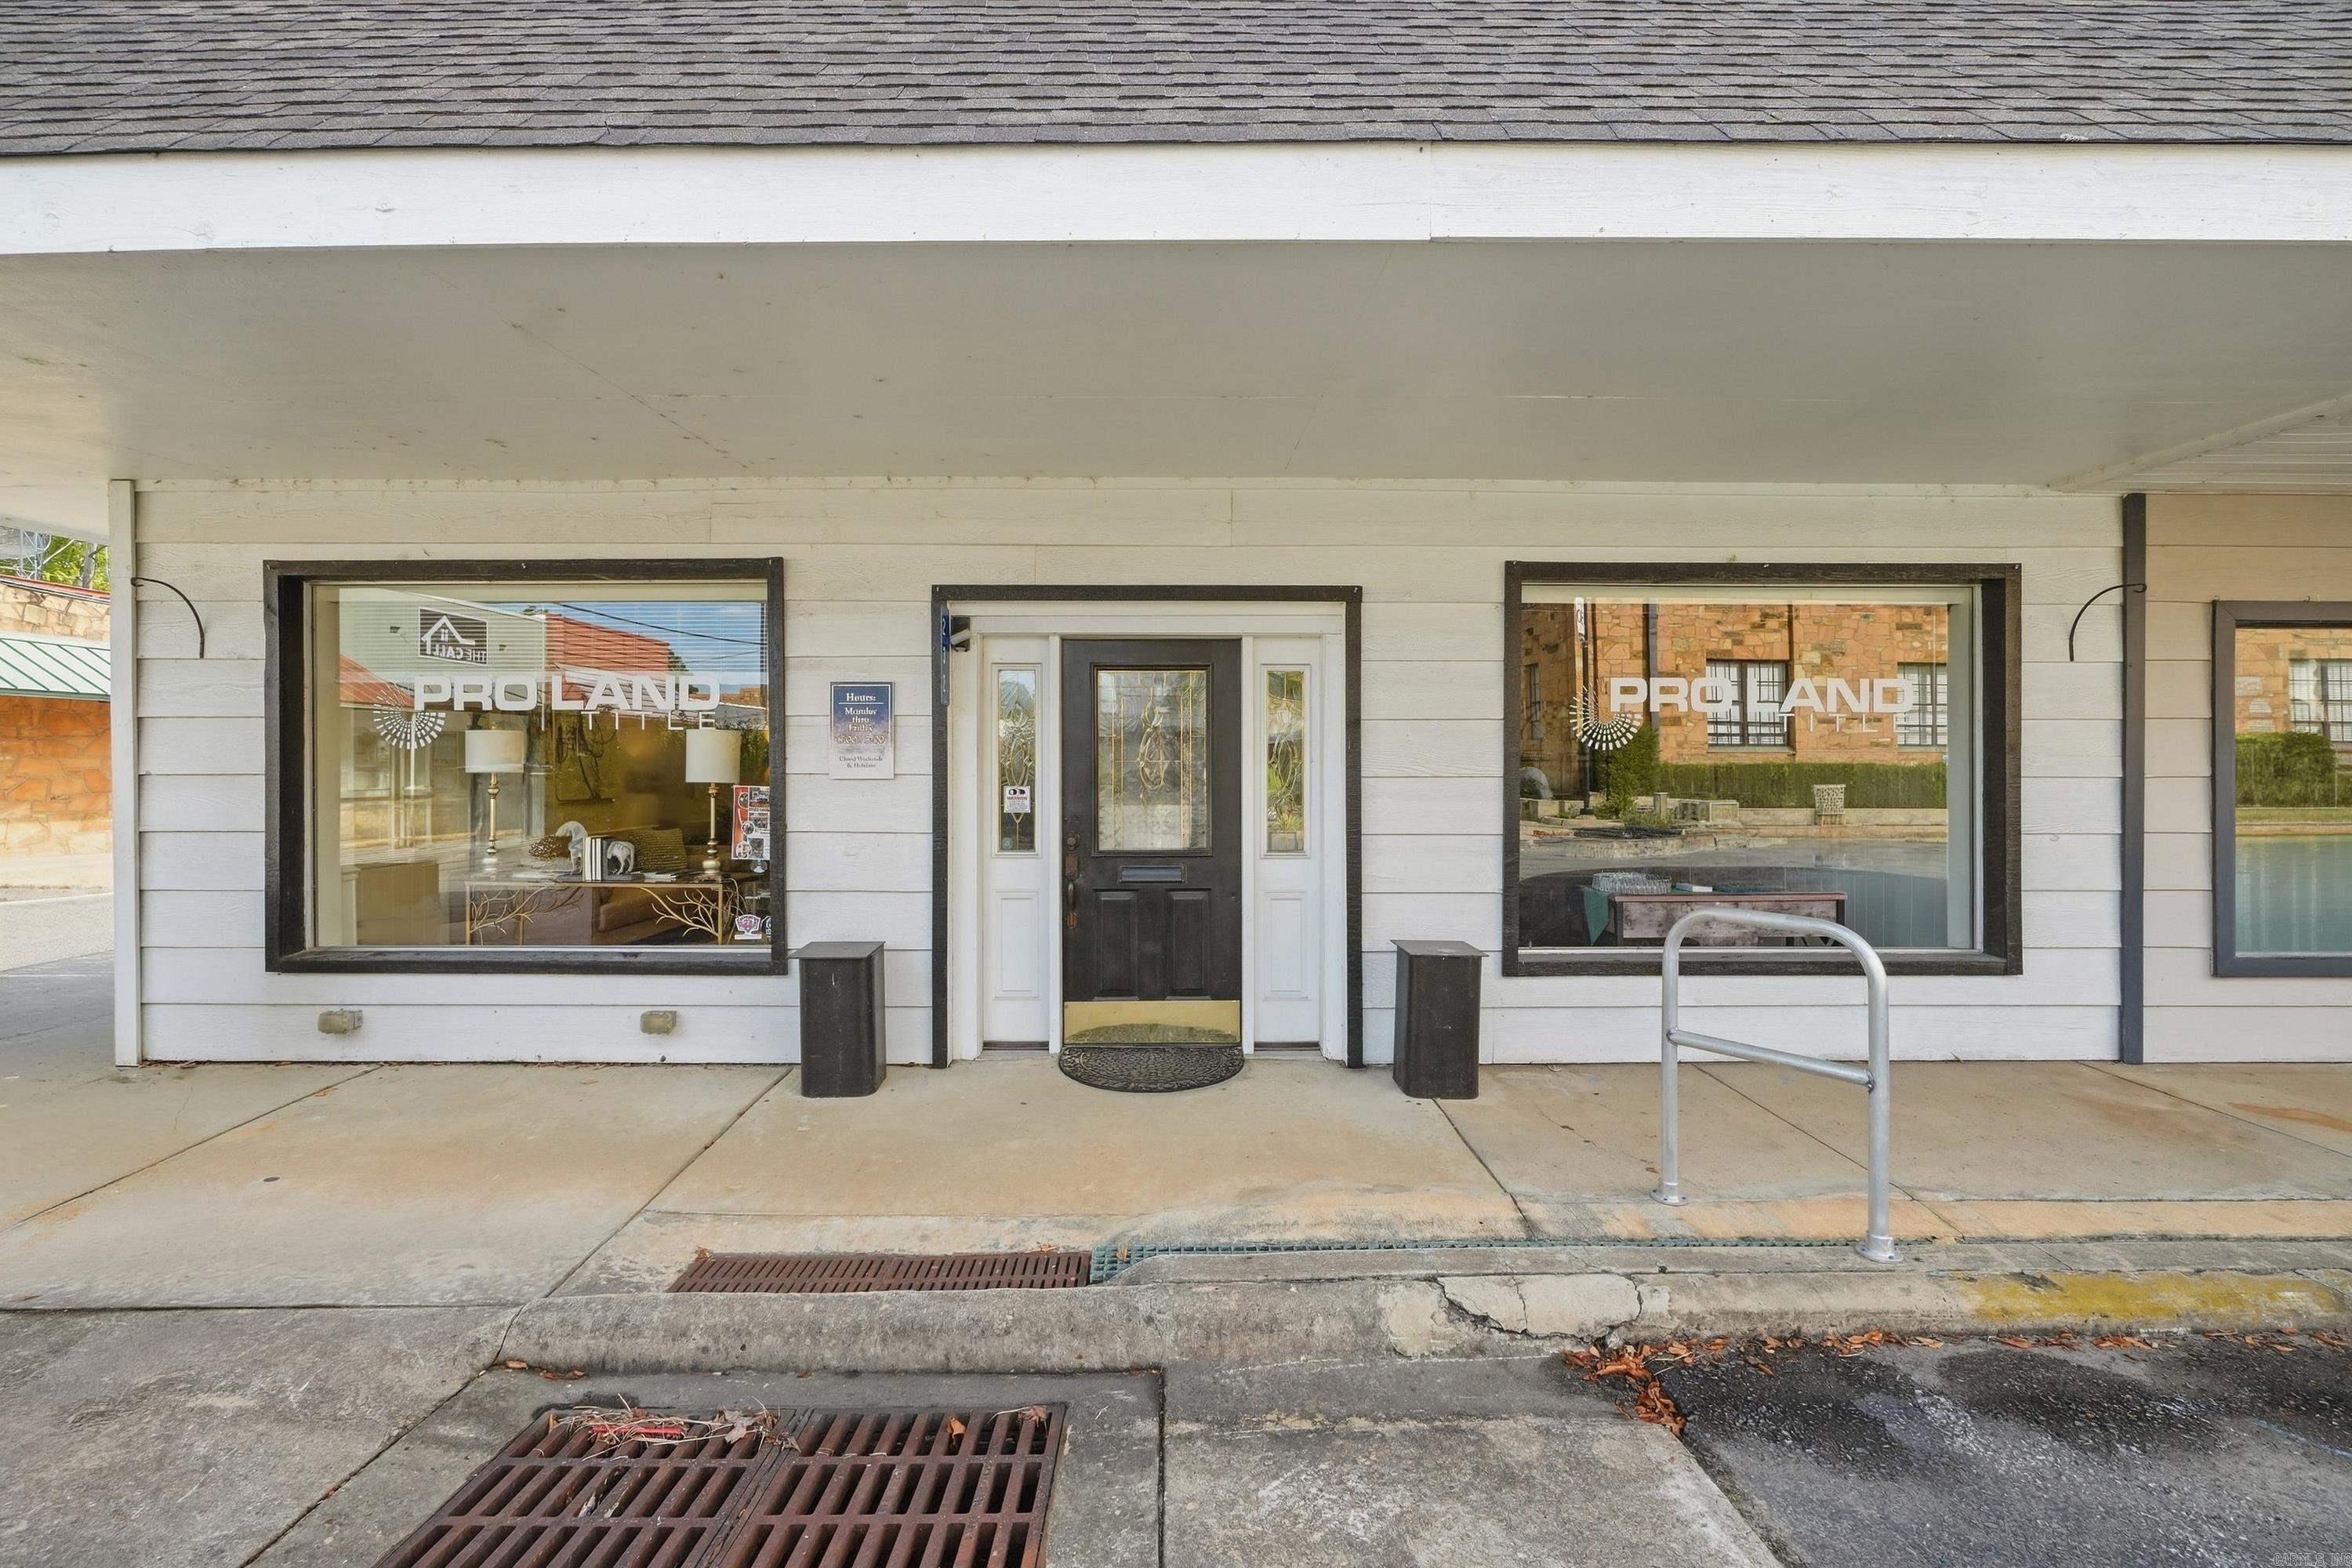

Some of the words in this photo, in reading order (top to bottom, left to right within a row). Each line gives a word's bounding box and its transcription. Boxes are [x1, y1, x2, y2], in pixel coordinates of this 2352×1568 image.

[413, 675, 538, 711] PRO
[551, 675, 720, 711] LAND
[846, 692, 877, 702] Hours:
[1610, 677, 1731, 713] PRO
[1747, 677, 1914, 713] LAND
[580, 710, 716, 731] TITLE
[844, 706, 877, 715] Monday
[1779, 713, 1911, 733] TITLE
